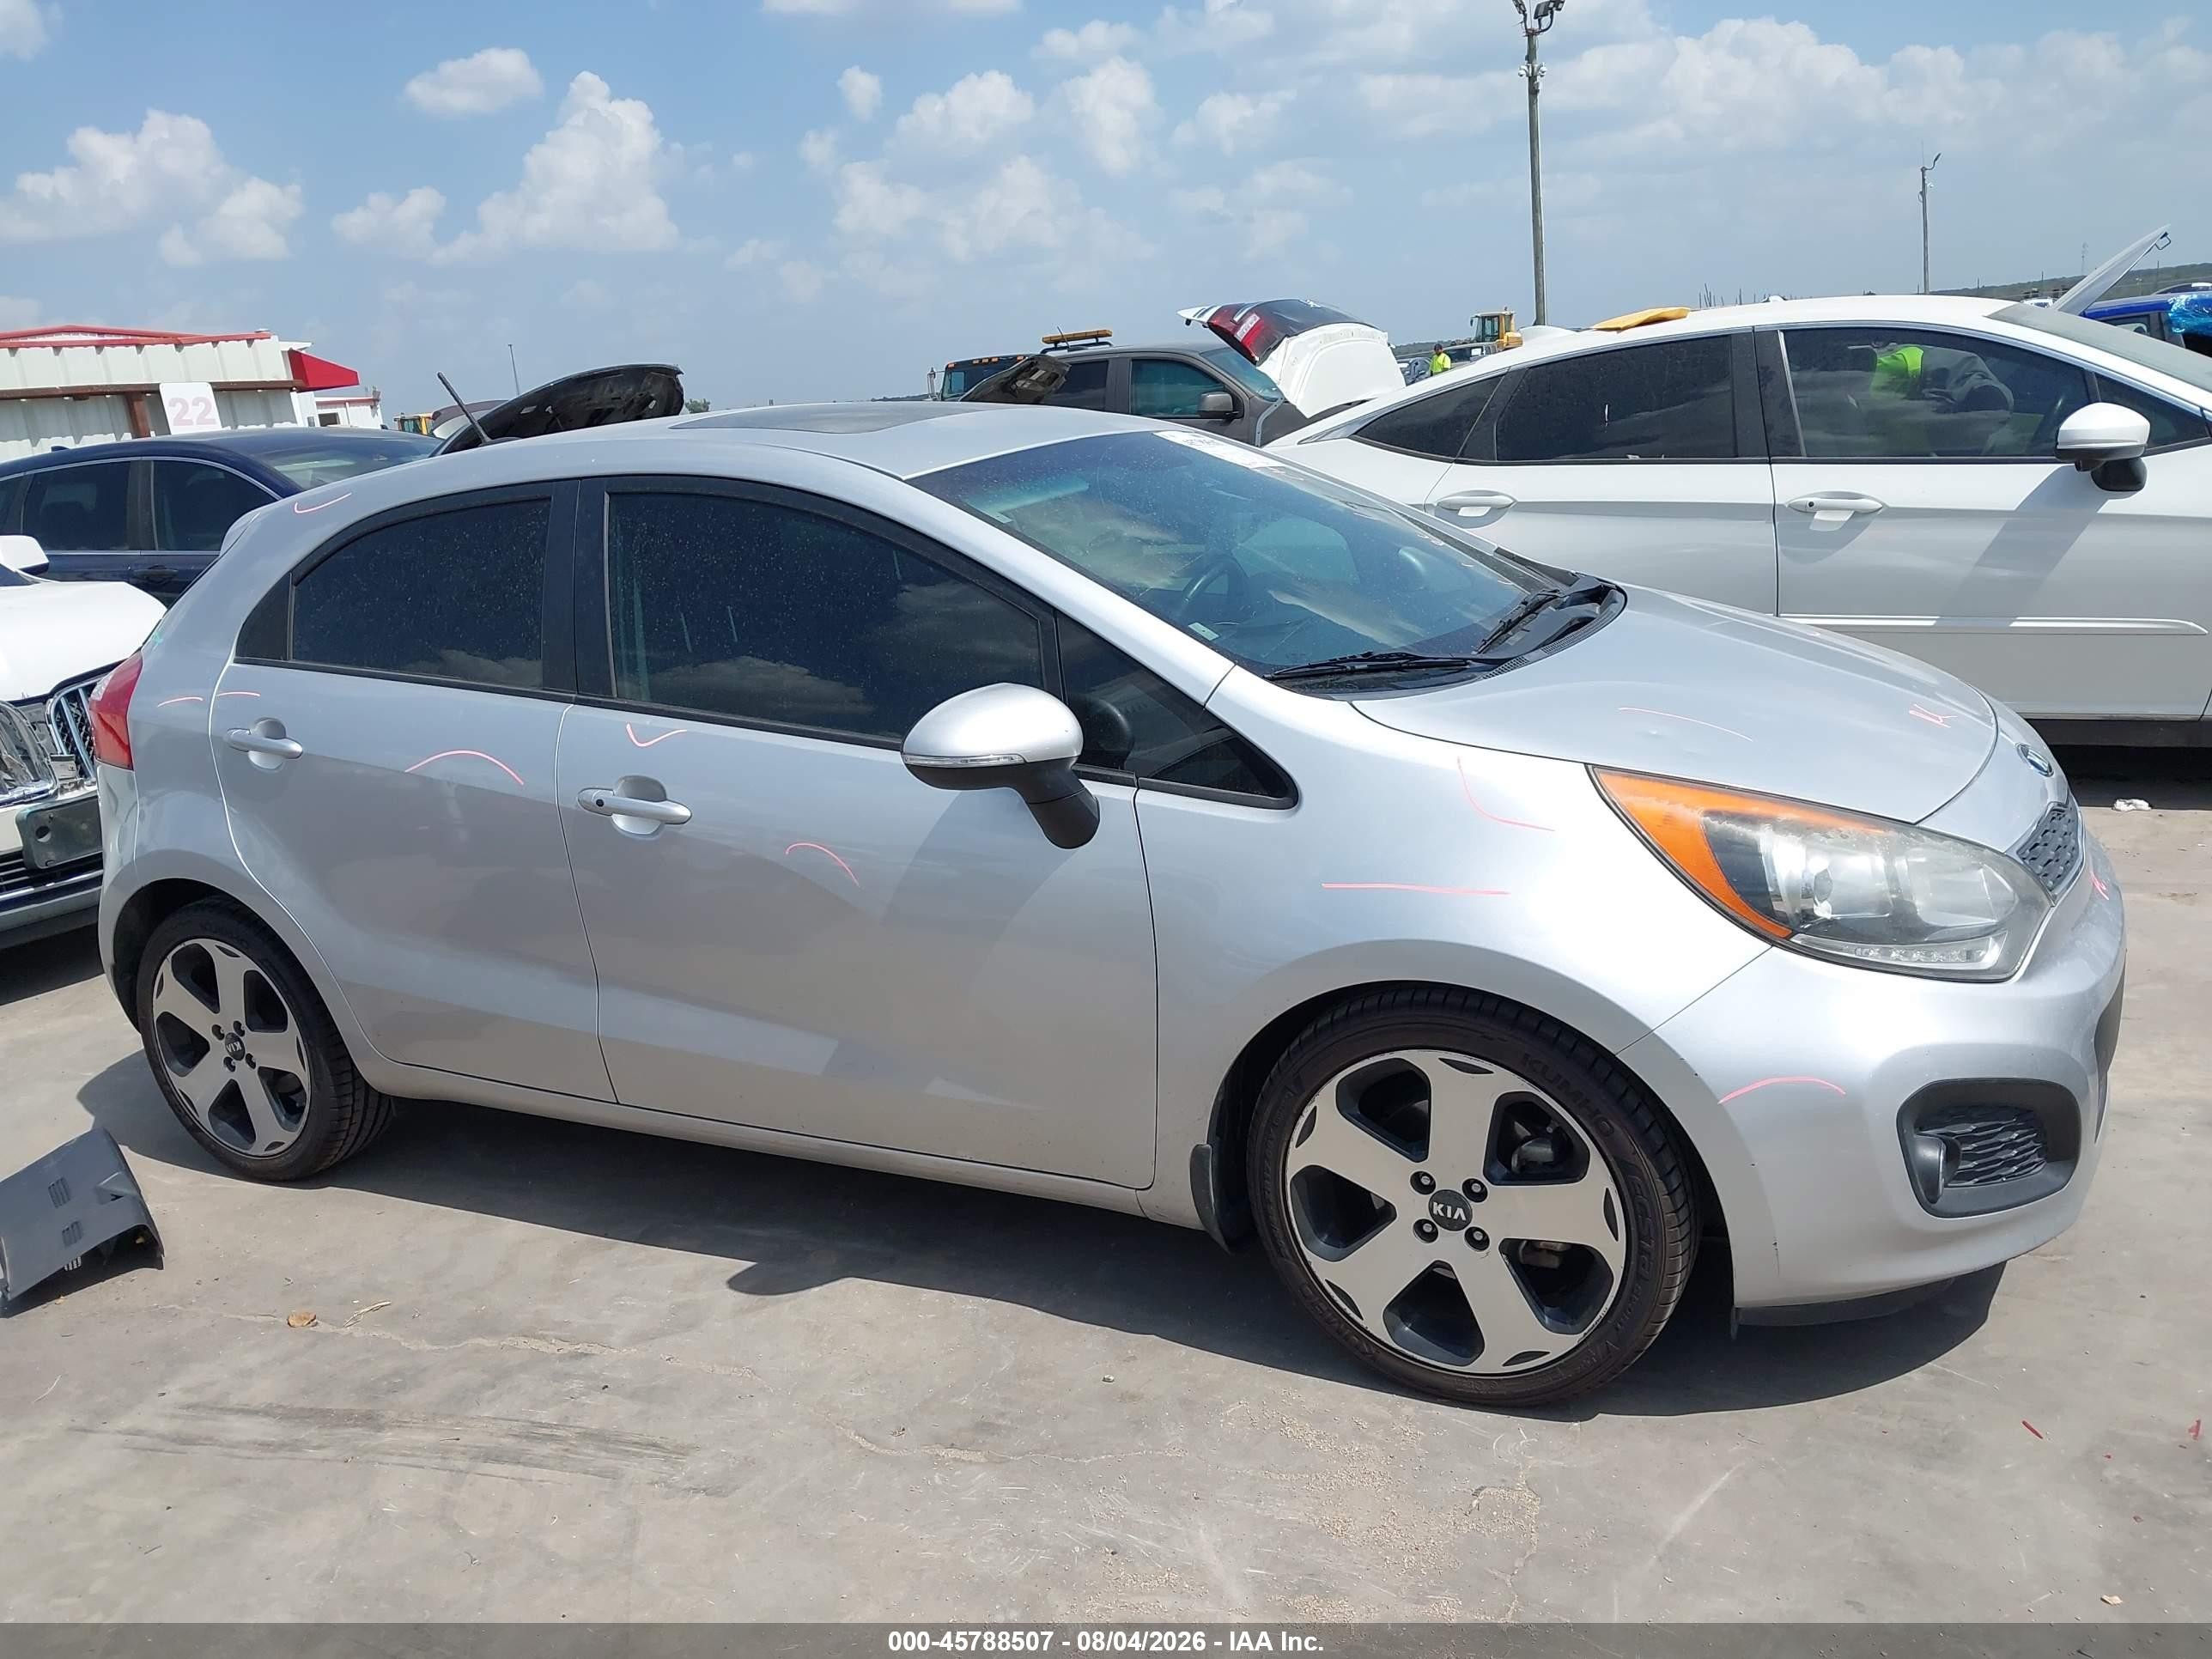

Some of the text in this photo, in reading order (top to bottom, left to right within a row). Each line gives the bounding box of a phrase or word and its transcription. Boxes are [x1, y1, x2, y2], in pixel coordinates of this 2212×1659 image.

[169, 398, 216, 426] 22
[227, 1042, 241, 1052] KIA
[1431, 1201, 1467, 1221] KIA
